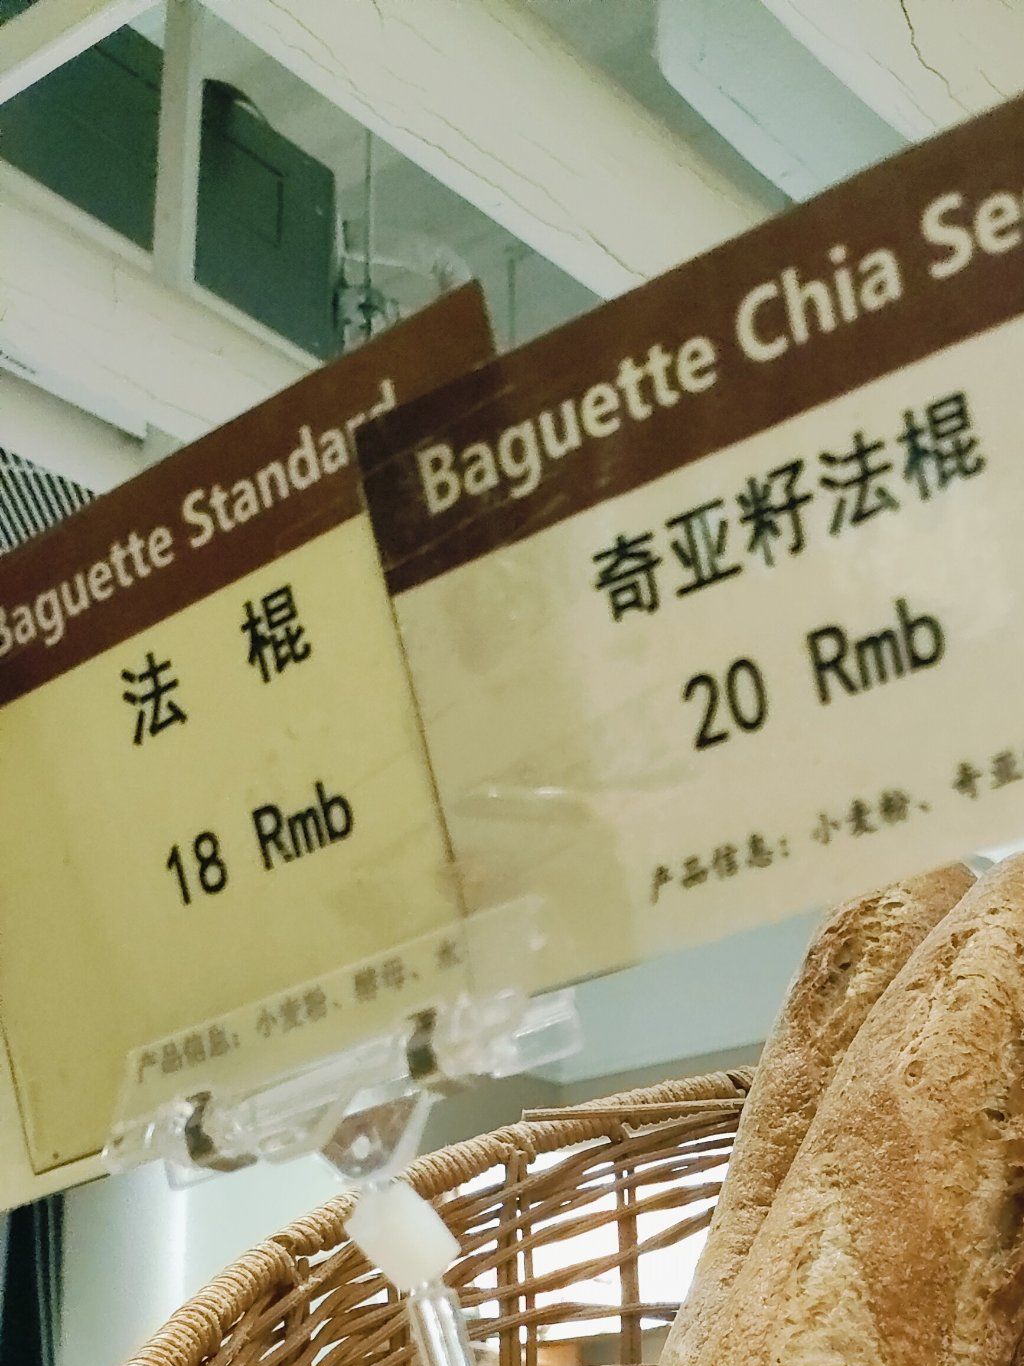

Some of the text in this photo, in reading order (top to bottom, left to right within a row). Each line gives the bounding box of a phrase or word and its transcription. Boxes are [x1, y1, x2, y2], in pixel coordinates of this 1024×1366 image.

[416, 335, 718, 518] Baguette
[735, 243, 903, 363] Chia
[591, 390, 987, 622] 奇亚籽法棍
[681, 596, 946, 751] 20 Rmb
[166, 780, 354, 906] 18 Rmb
